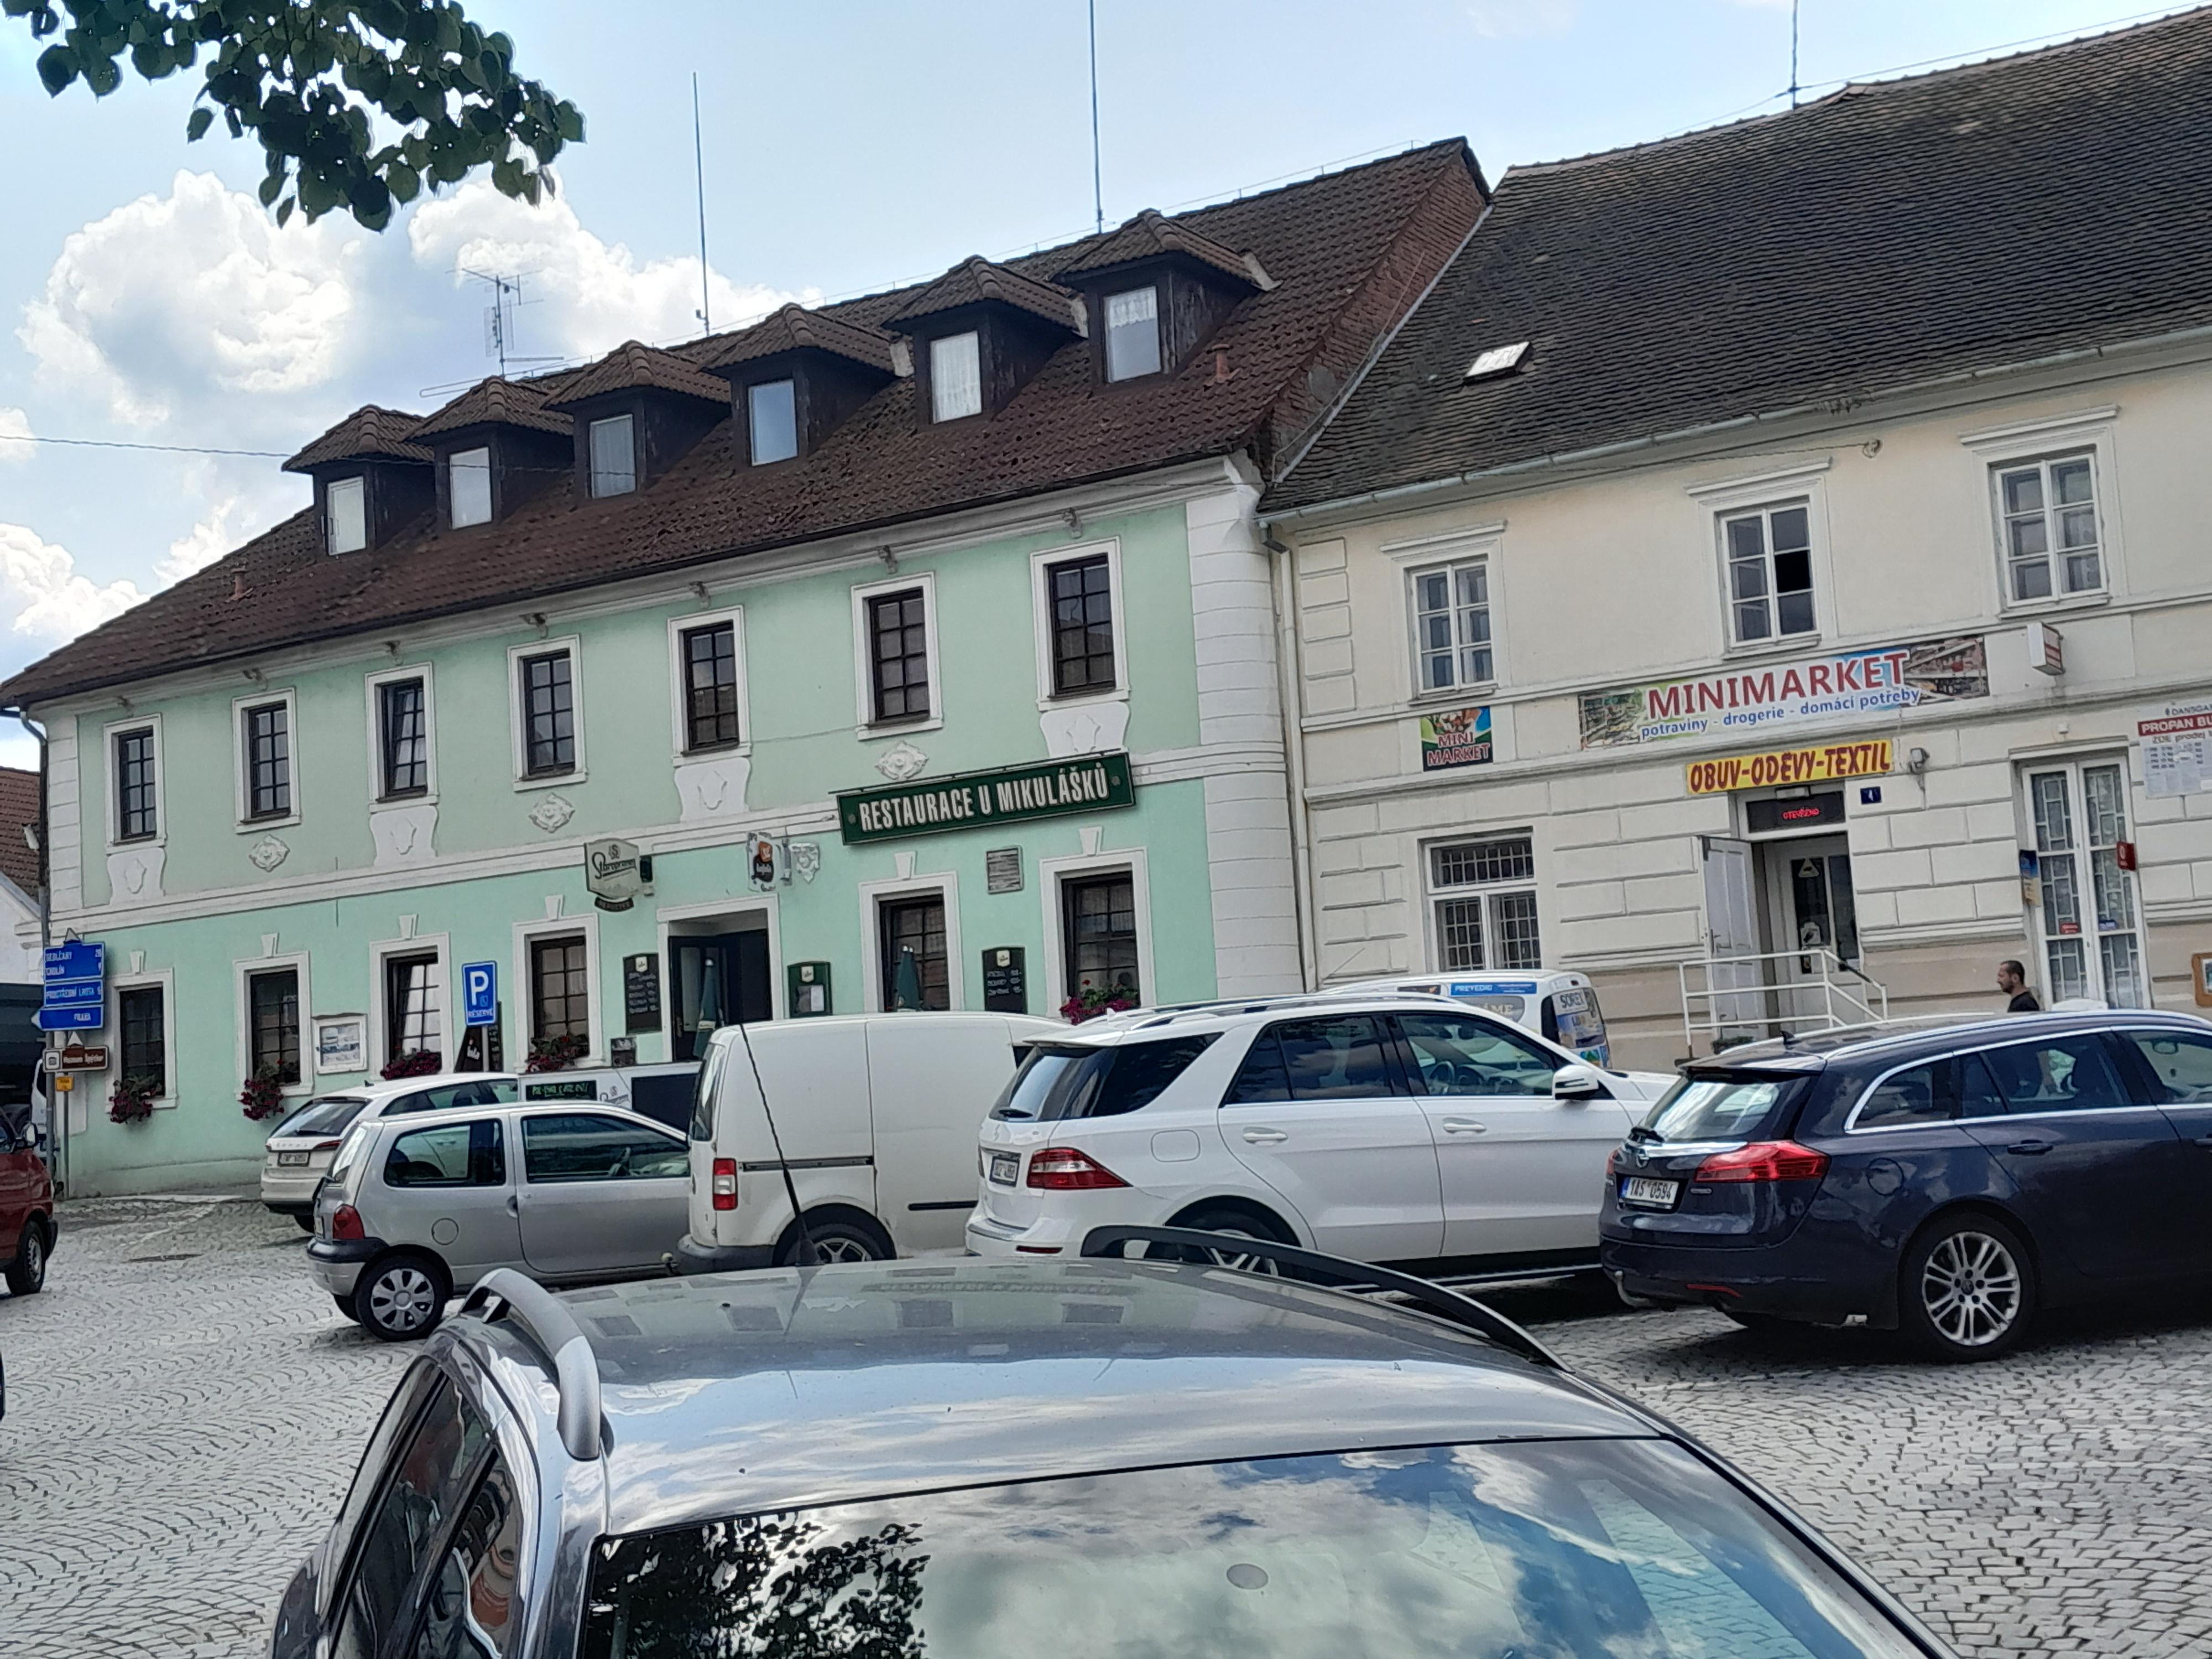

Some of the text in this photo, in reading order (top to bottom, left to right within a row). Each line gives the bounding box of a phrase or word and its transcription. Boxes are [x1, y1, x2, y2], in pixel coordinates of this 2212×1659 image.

[1648, 653, 1908, 719] MINIMARKET
[1642, 719, 1708, 739] potraviny
[1723, 706, 1785, 726] drogerie
[1800, 697, 1854, 715] domácí
[1860, 687, 1921, 708] potřeby
[2141, 718, 2194, 734] PROPAN
[1428, 744, 1490, 765] MARKET
[1438, 731, 1474, 747] MINI
[859, 761, 1109, 832] RESTAURACE U MIKULÁŠKŮ
[470, 971, 489, 1006] P
